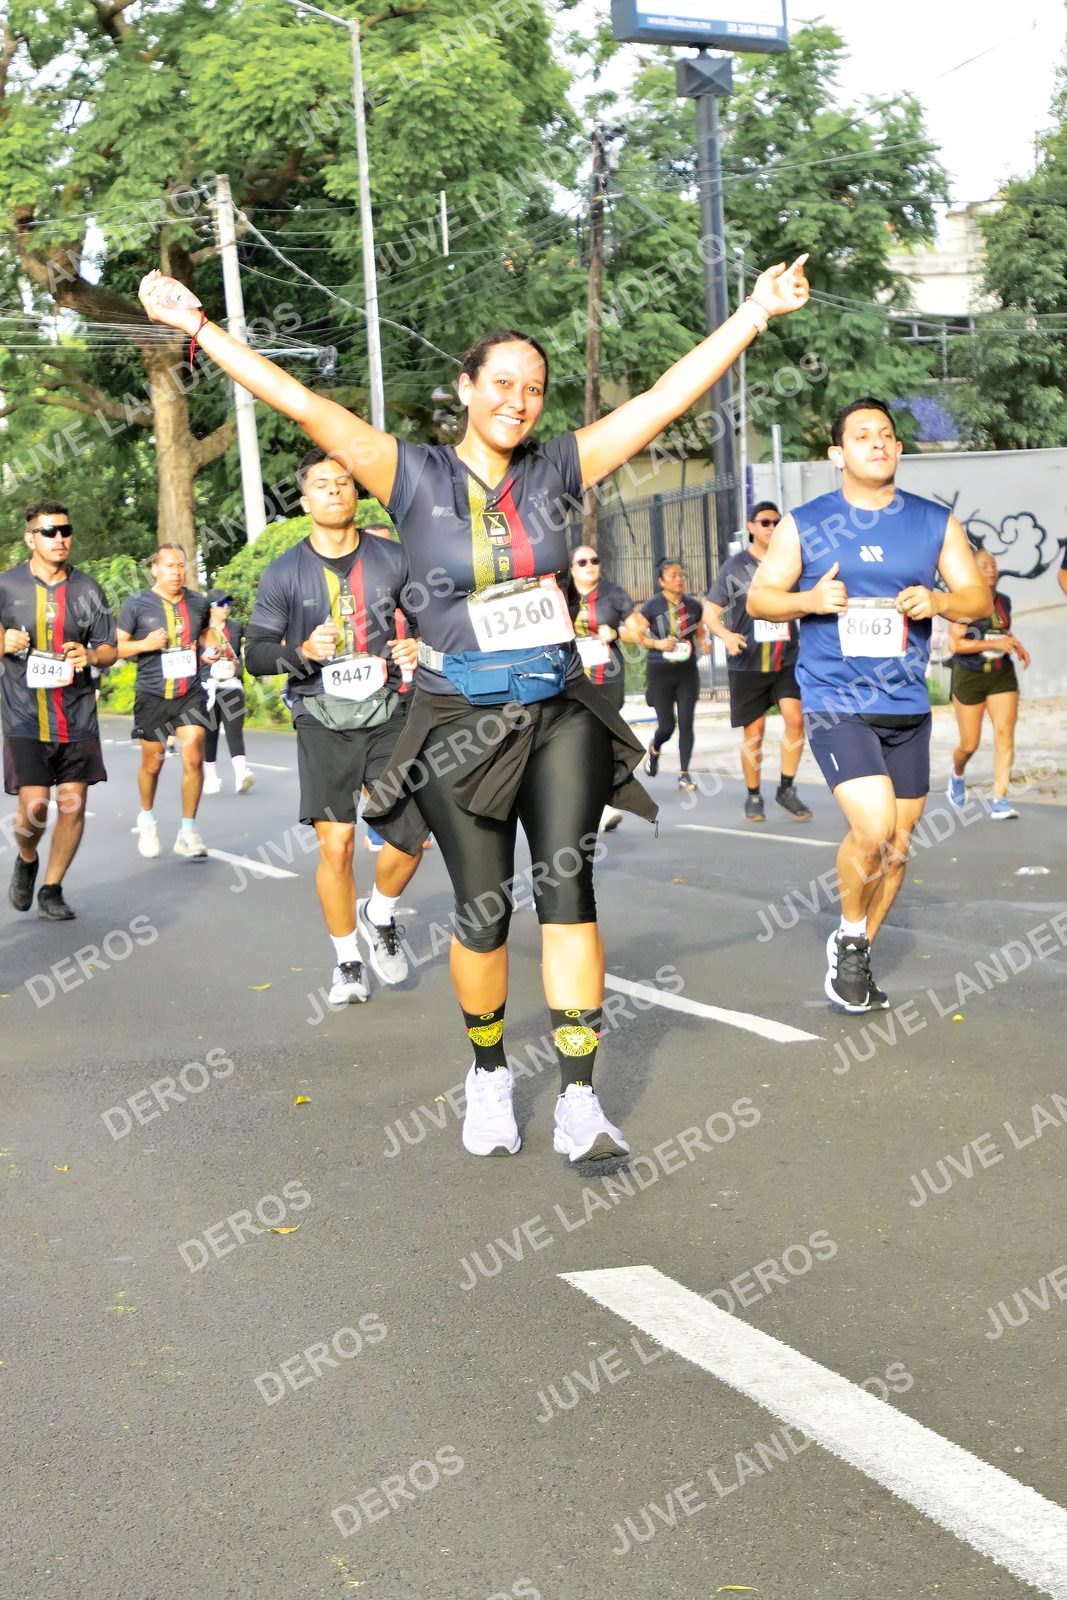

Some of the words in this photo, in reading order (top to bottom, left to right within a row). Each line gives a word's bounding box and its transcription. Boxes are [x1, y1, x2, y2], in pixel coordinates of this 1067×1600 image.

[479, 597, 555, 638] 13260
[847, 617, 892, 635] 8663
[32, 662, 63, 677] 8344
[331, 665, 372, 686] 8447
